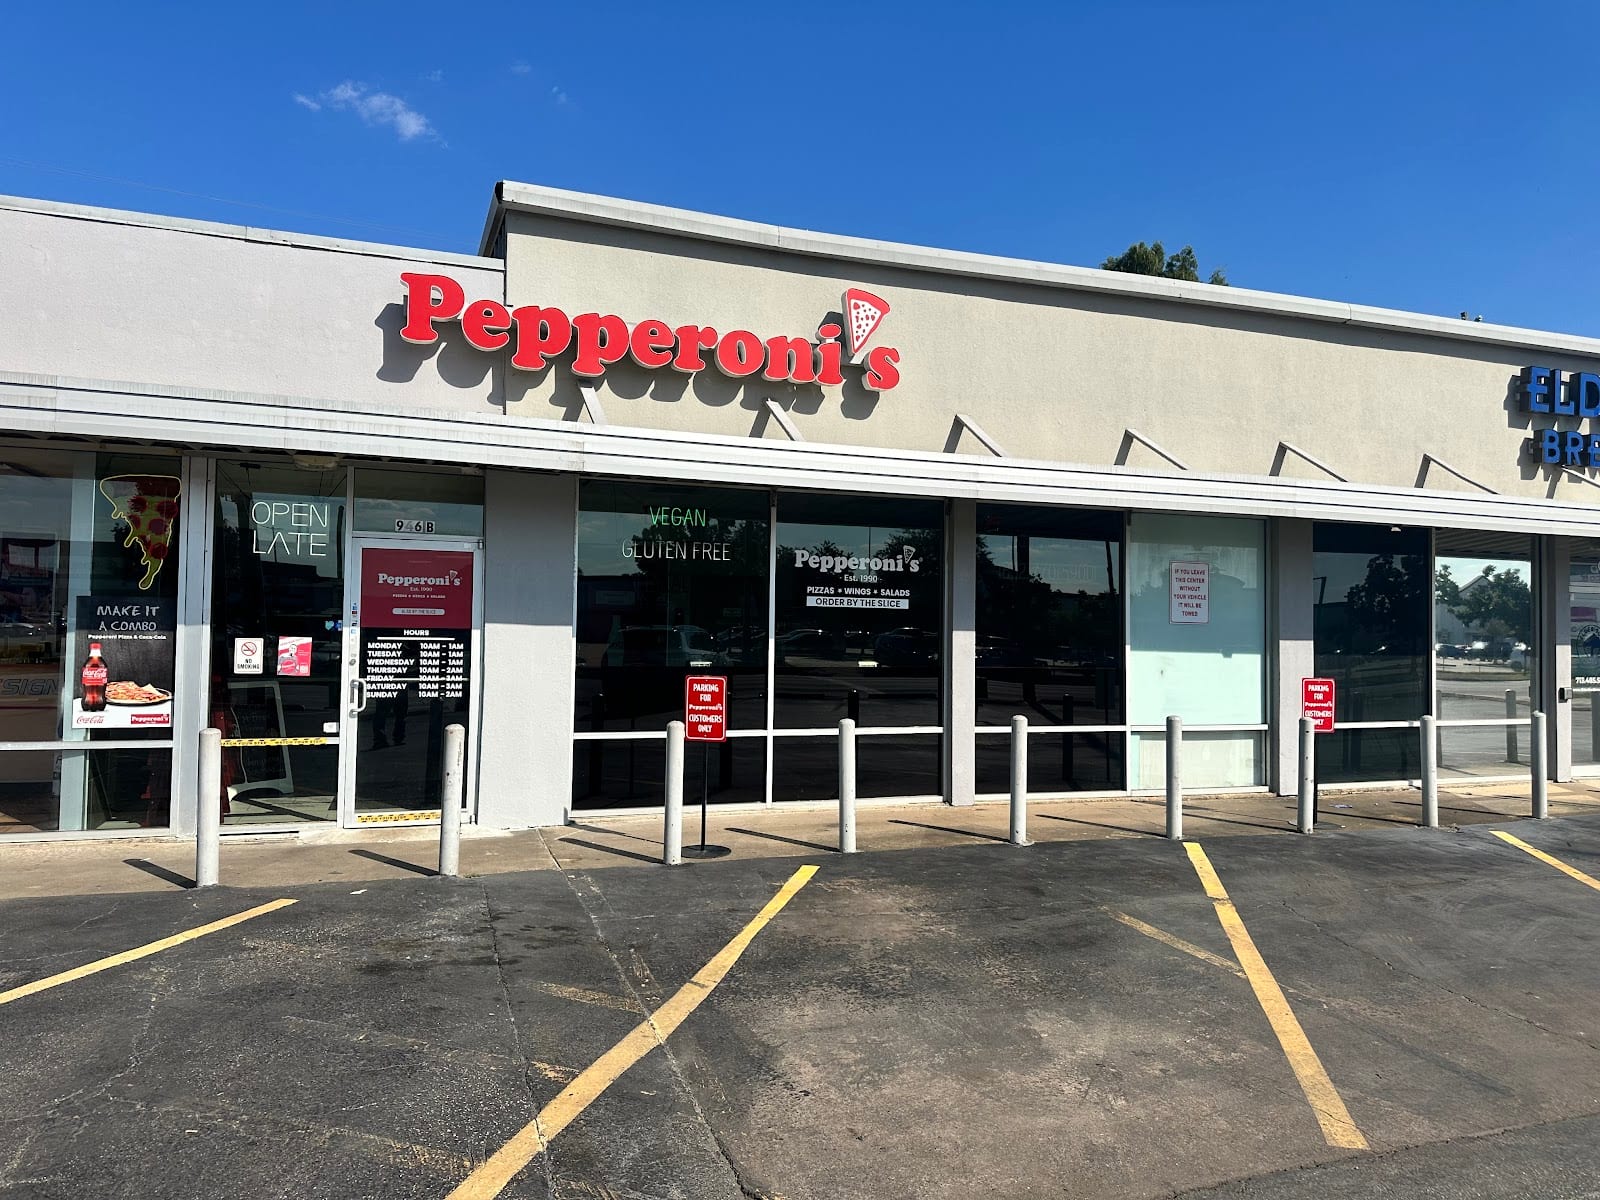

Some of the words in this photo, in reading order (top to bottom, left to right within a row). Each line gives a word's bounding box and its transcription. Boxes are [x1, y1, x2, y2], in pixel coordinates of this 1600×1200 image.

[400, 271, 900, 391] Pepperoni's
[251, 501, 328, 527] OPEN
[649, 505, 706, 527] VEGAN
[252, 530, 327, 556] LATE
[622, 539, 687, 560] GLUTEN
[692, 541, 731, 561] FREE
[794, 545, 920, 573] Pepperoni's
[377, 570, 461, 587] Pepperoni's
[844, 574, 858, 582] Est.
[860, 574, 878, 583] 1990
[807, 586, 835, 594] PIZZAS
[844, 587, 871, 596] WINGS
[880, 588, 911, 597] SALADS
[815, 597, 845, 606] ORDER
[847, 598, 858, 606] BY
[860, 598, 875, 607] THE
[877, 599, 901, 608] SLICE
[96, 605, 141, 617] MAKE
[145, 605, 160, 617] IT
[99, 621, 107, 631] A
[110, 621, 157, 631] COMBO
[0, 678, 59, 697] SIGN
[693, 683, 719, 692] PARKING
[699, 693, 712, 702] FOR
[688, 713, 722, 723] CUSTOMERS
[1304, 710, 1332, 718] CUSTOMERS
[697, 724, 712, 733] ONLY
